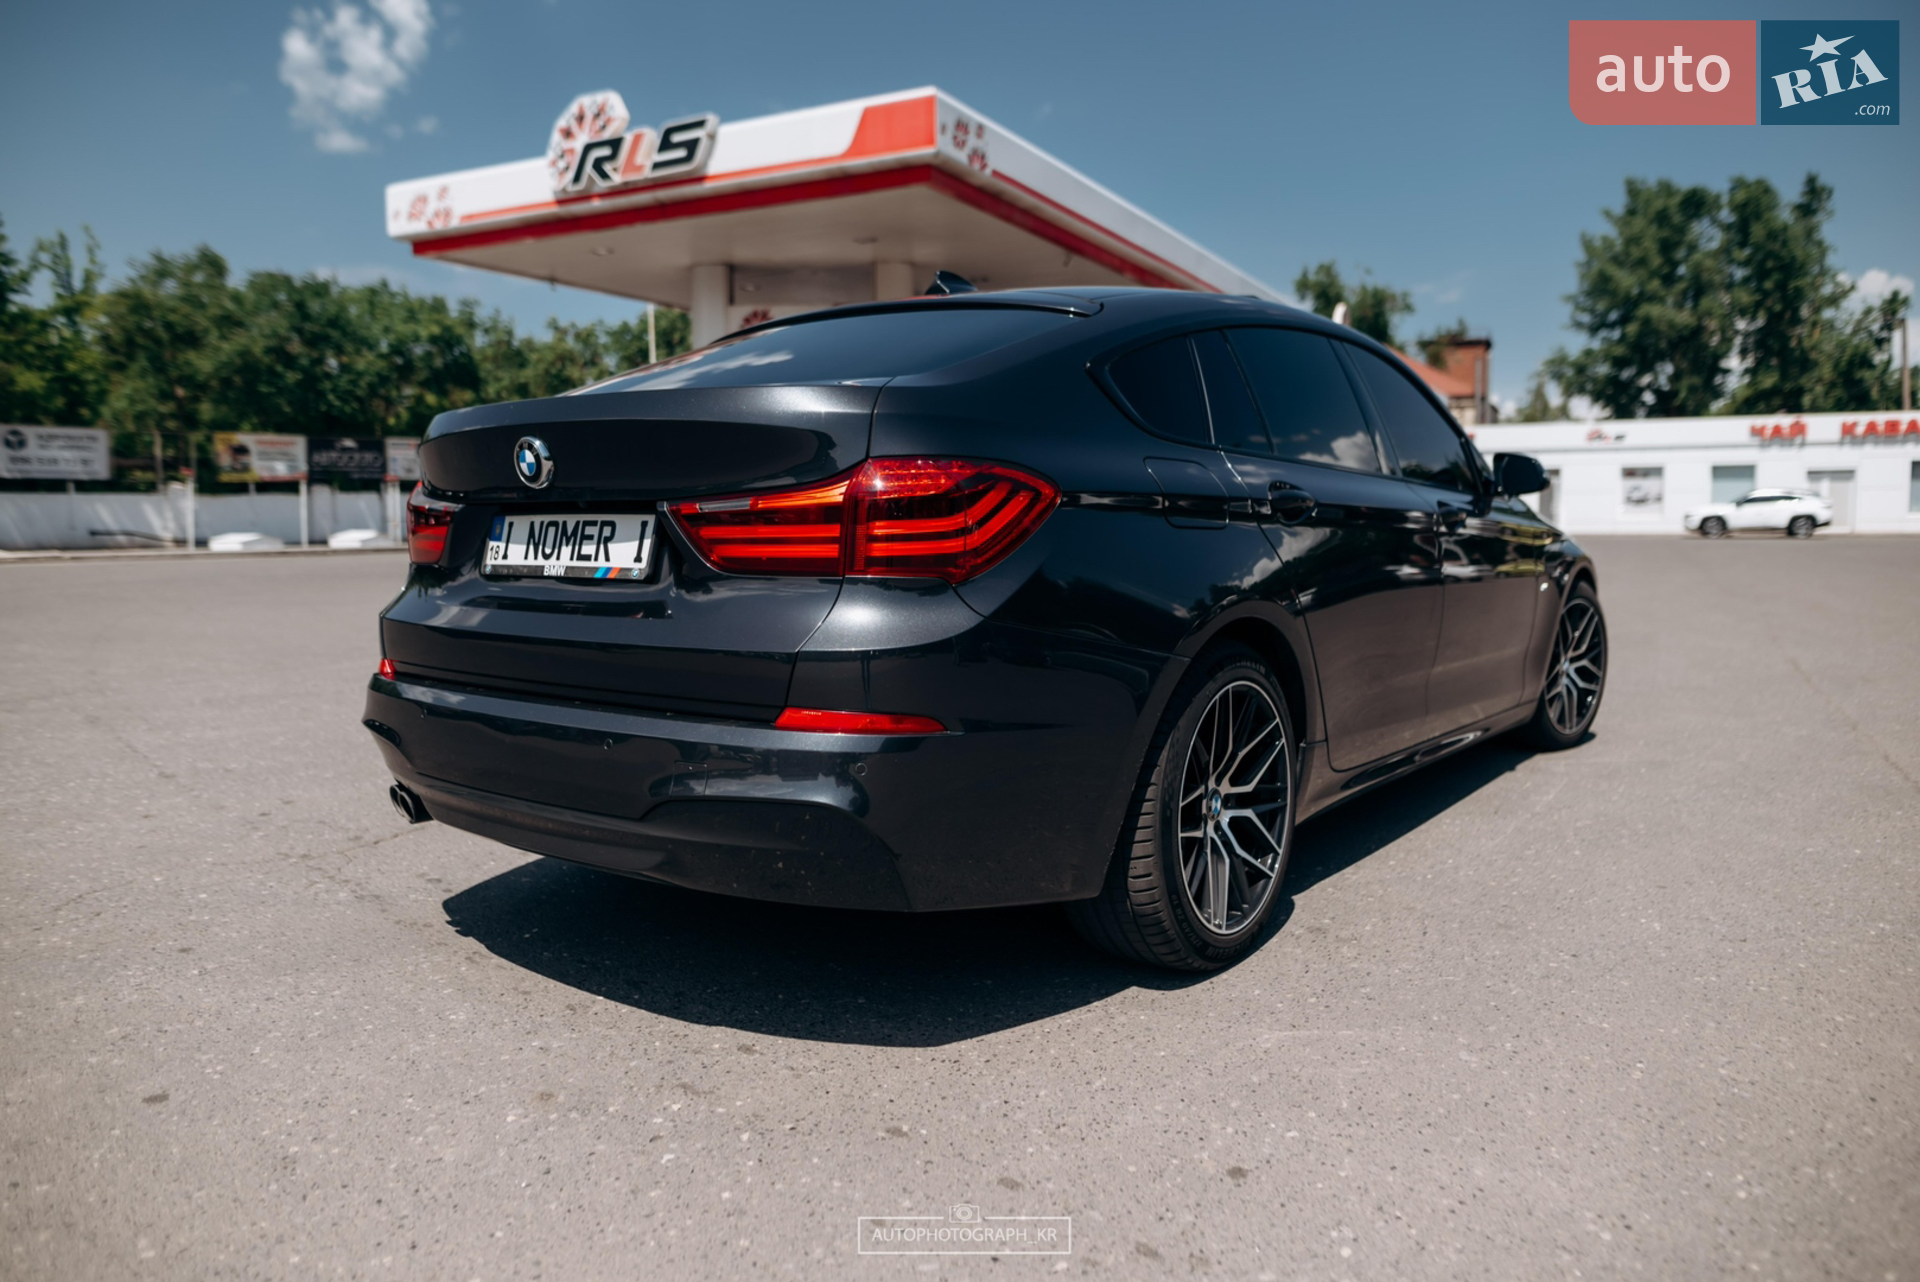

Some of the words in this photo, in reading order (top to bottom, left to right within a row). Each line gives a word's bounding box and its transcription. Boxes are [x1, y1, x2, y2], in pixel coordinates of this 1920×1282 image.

[569, 117, 710, 189] RLS
[1750, 415, 1807, 440] ЧАЙ
[489, 545, 500, 561] 18
[524, 520, 617, 562] NOMER
[543, 565, 566, 576] BMW
